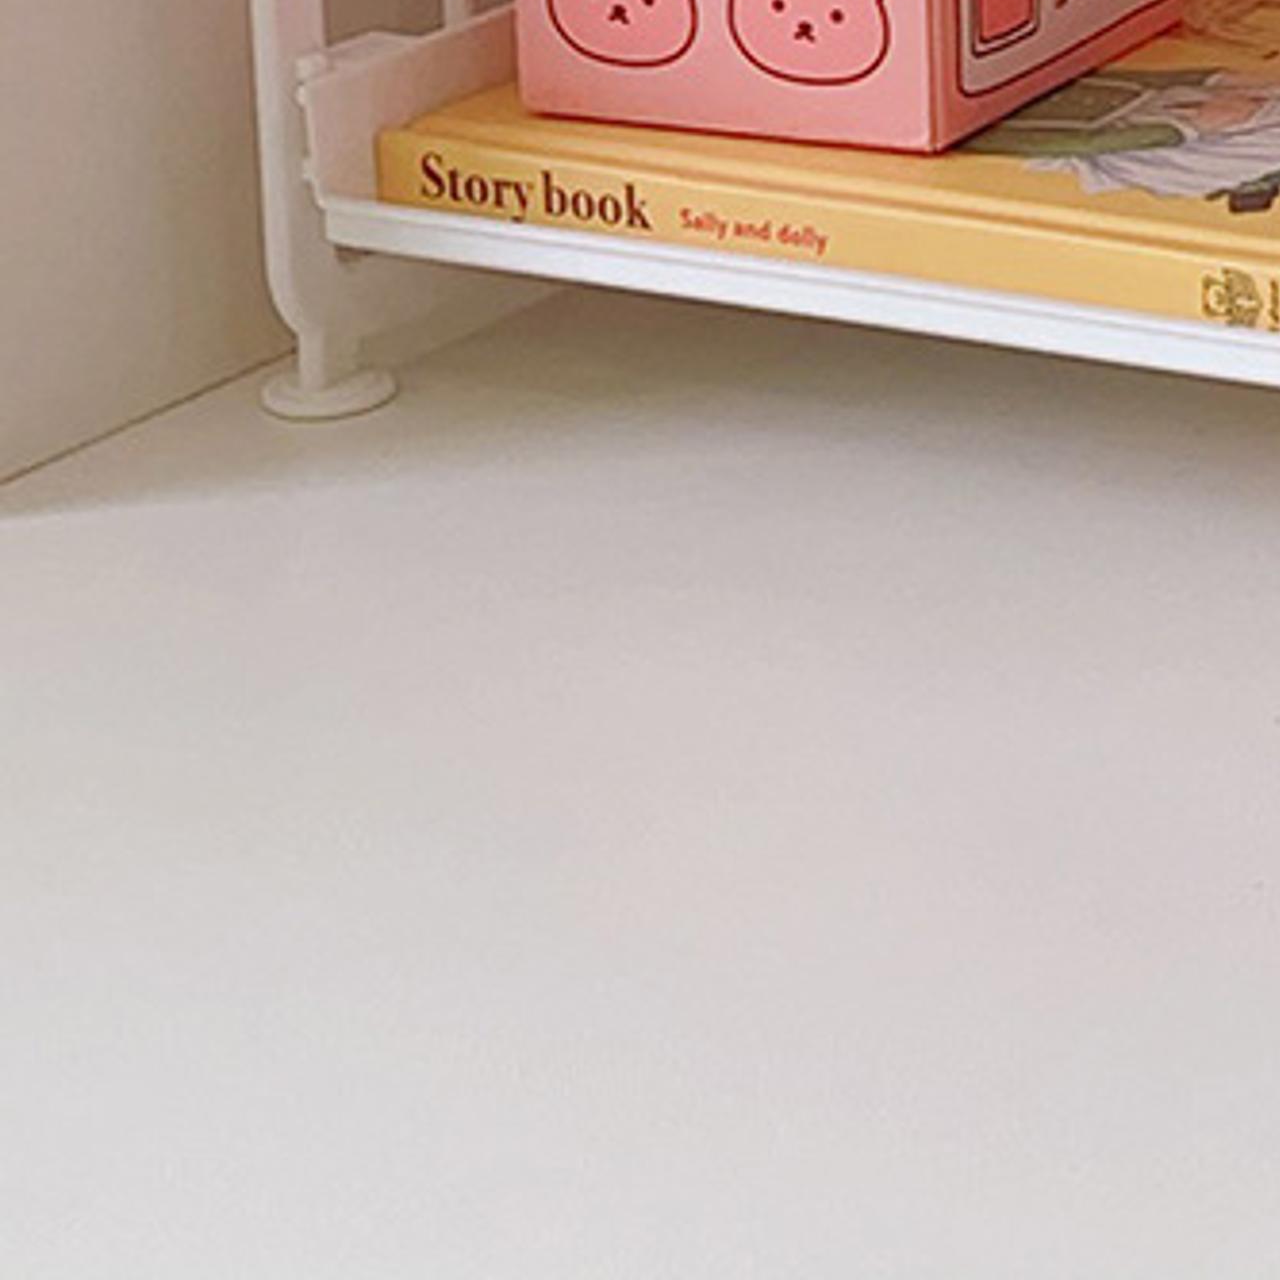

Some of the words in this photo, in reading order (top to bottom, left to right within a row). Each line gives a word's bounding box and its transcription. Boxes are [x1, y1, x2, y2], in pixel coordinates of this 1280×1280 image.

[420, 152, 534, 223] Story
[541, 170, 652, 231] book
[679, 208, 728, 241] Sally
[733, 220, 771, 242] and
